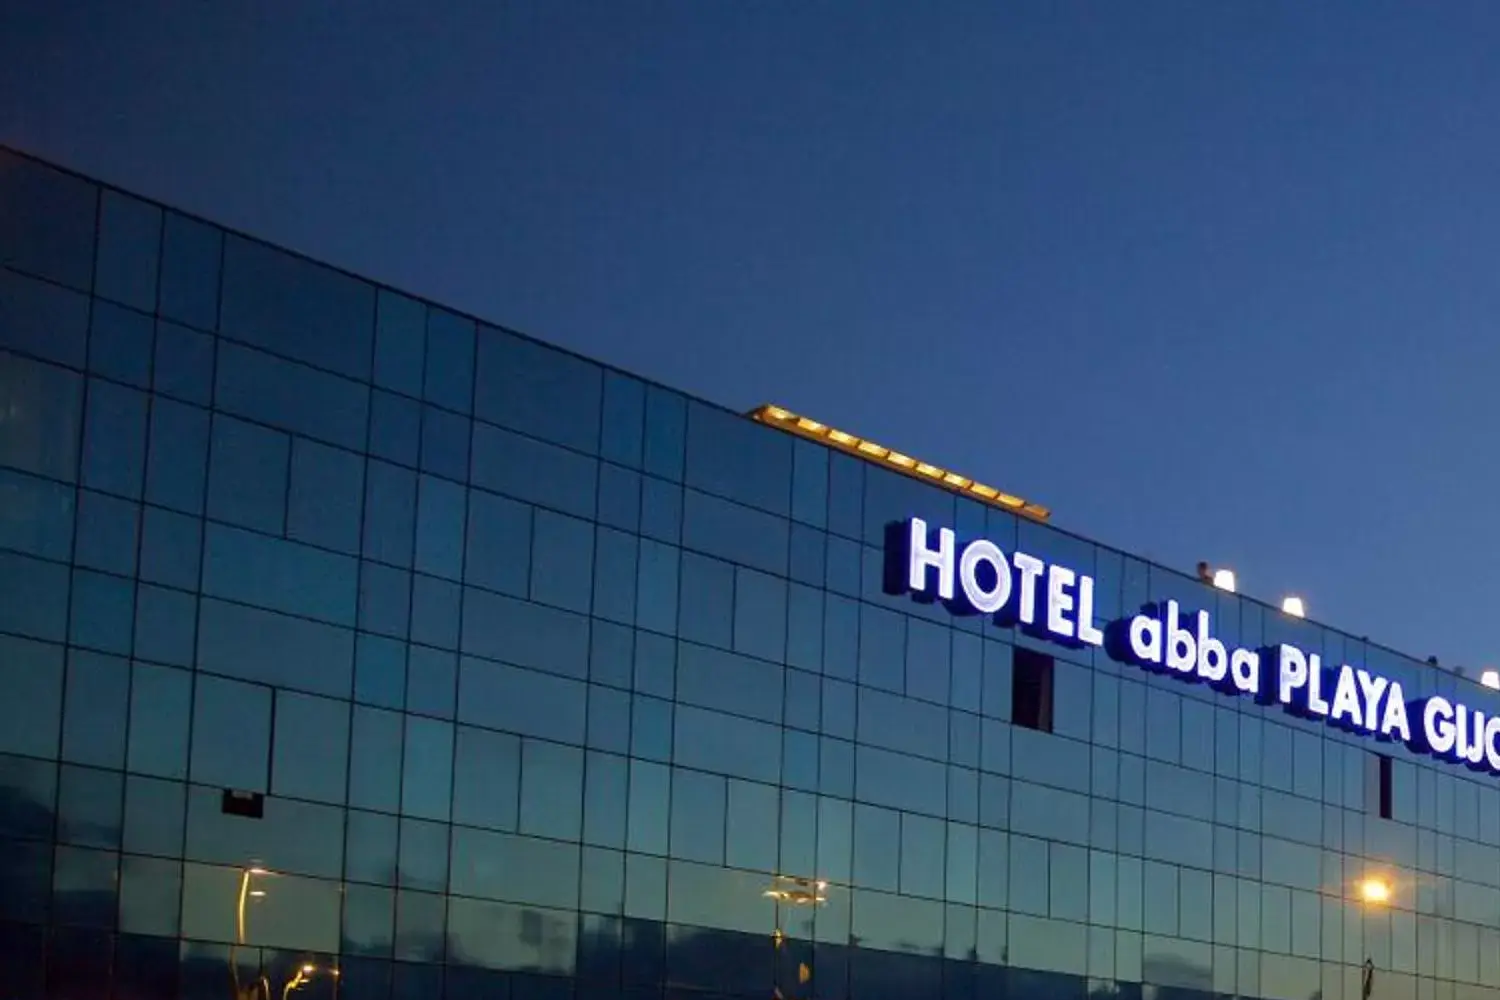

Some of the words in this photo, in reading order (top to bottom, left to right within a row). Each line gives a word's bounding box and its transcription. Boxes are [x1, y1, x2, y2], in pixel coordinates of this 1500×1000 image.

[908, 516, 1104, 647] HOTEL
[1129, 599, 1260, 694] abba
[1279, 643, 1411, 742] PLAYA
